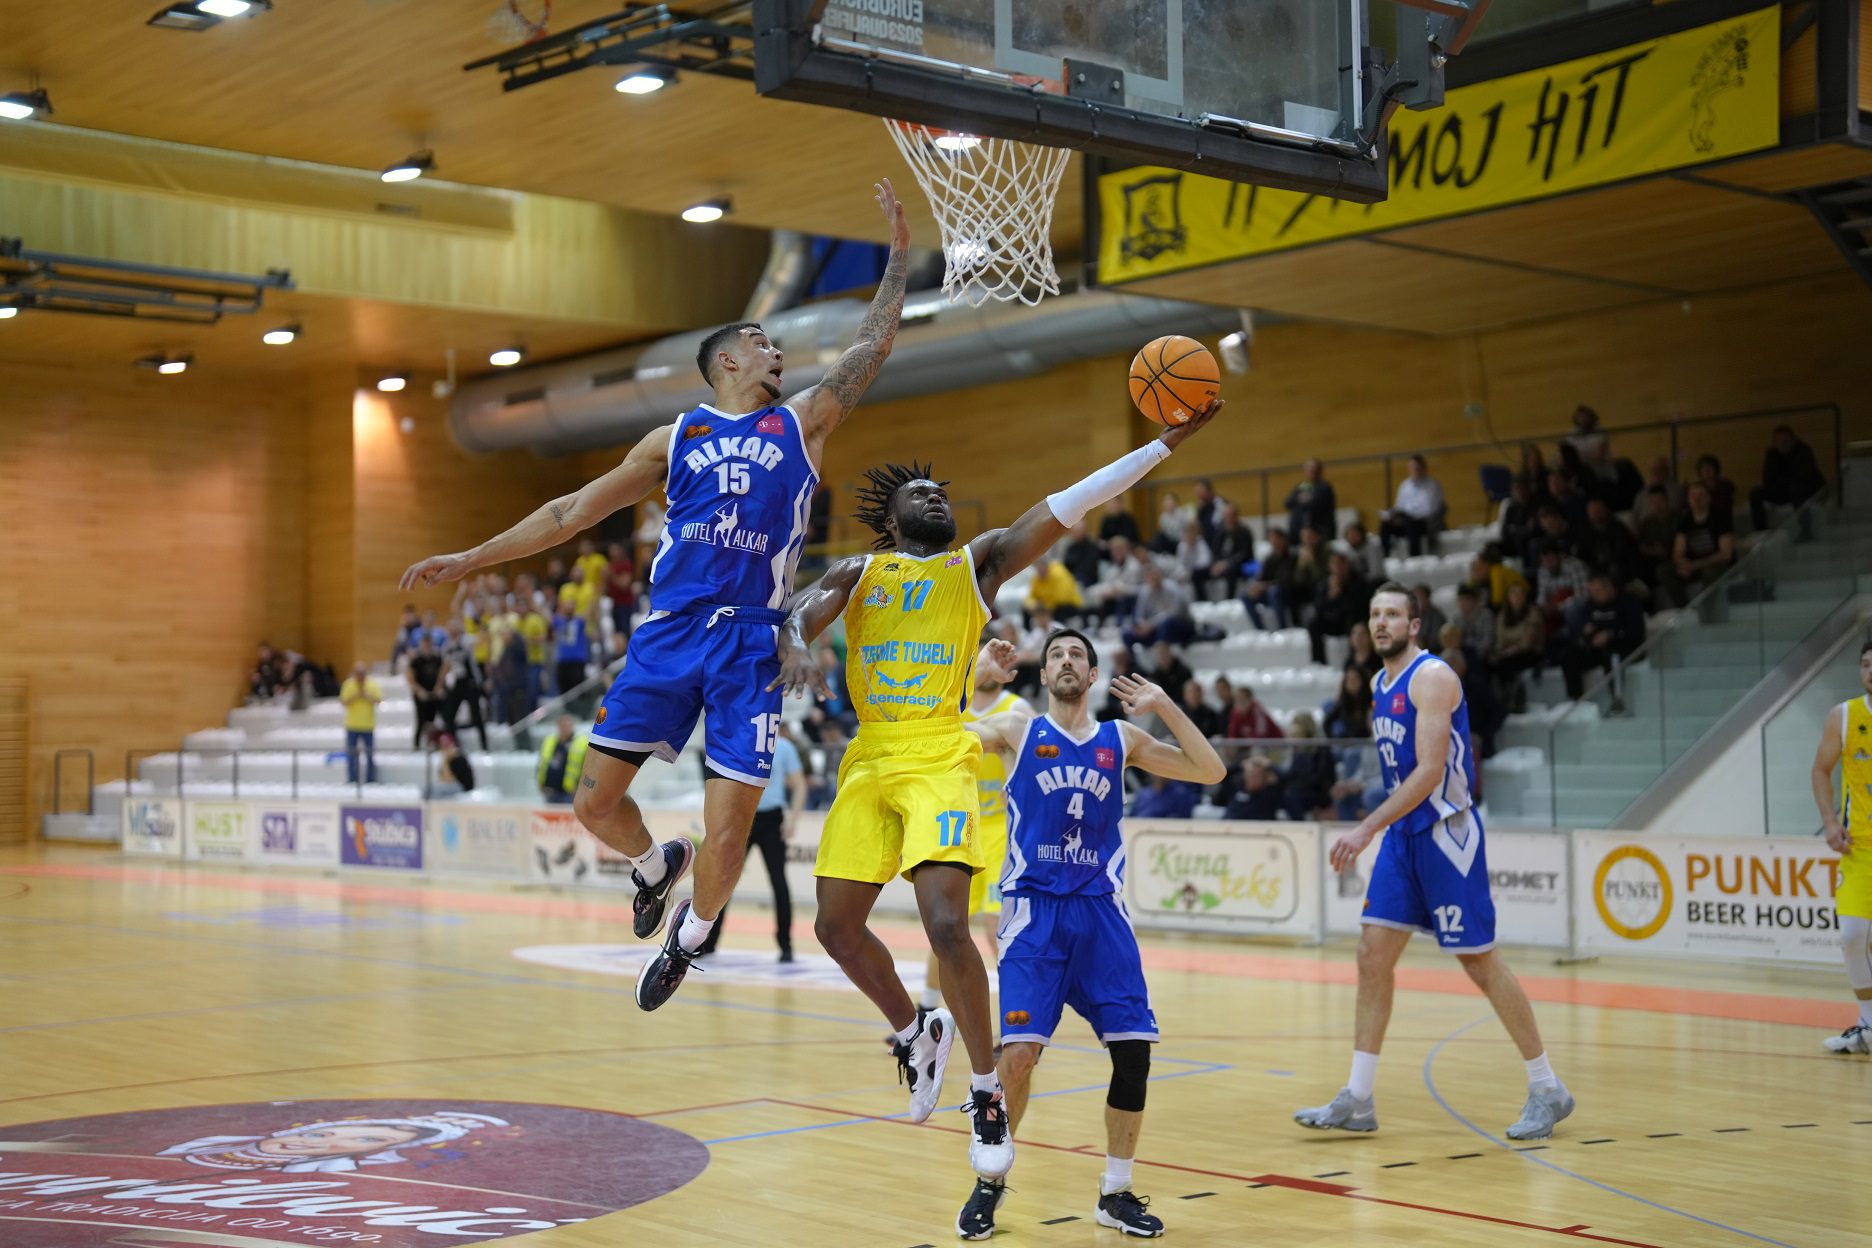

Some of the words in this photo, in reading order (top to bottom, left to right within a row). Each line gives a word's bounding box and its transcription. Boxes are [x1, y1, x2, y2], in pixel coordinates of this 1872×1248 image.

[1388, 101, 1504, 190] MOJ
[1527, 47, 1656, 183] HIT
[684, 436, 784, 475] ALKAR
[713, 462, 751, 495] 15
[681, 522, 711, 542] HOTEL
[732, 529, 769, 553] ALKAR
[902, 580, 934, 612] 17
[903, 641, 954, 666] TUHELJ
[751, 712, 780, 754] 15
[1379, 742, 1398, 767] 12
[1035, 765, 1111, 802] ALKAR
[1066, 792, 1084, 820] 4
[936, 809, 968, 847] 17
[1037, 844, 1063, 861] HOTEL
[1685, 854, 1841, 899] PUNKT
[1433, 904, 1464, 932] 12
[1687, 900, 1747, 926] BEER
[227, 1217, 291, 1229] OD
